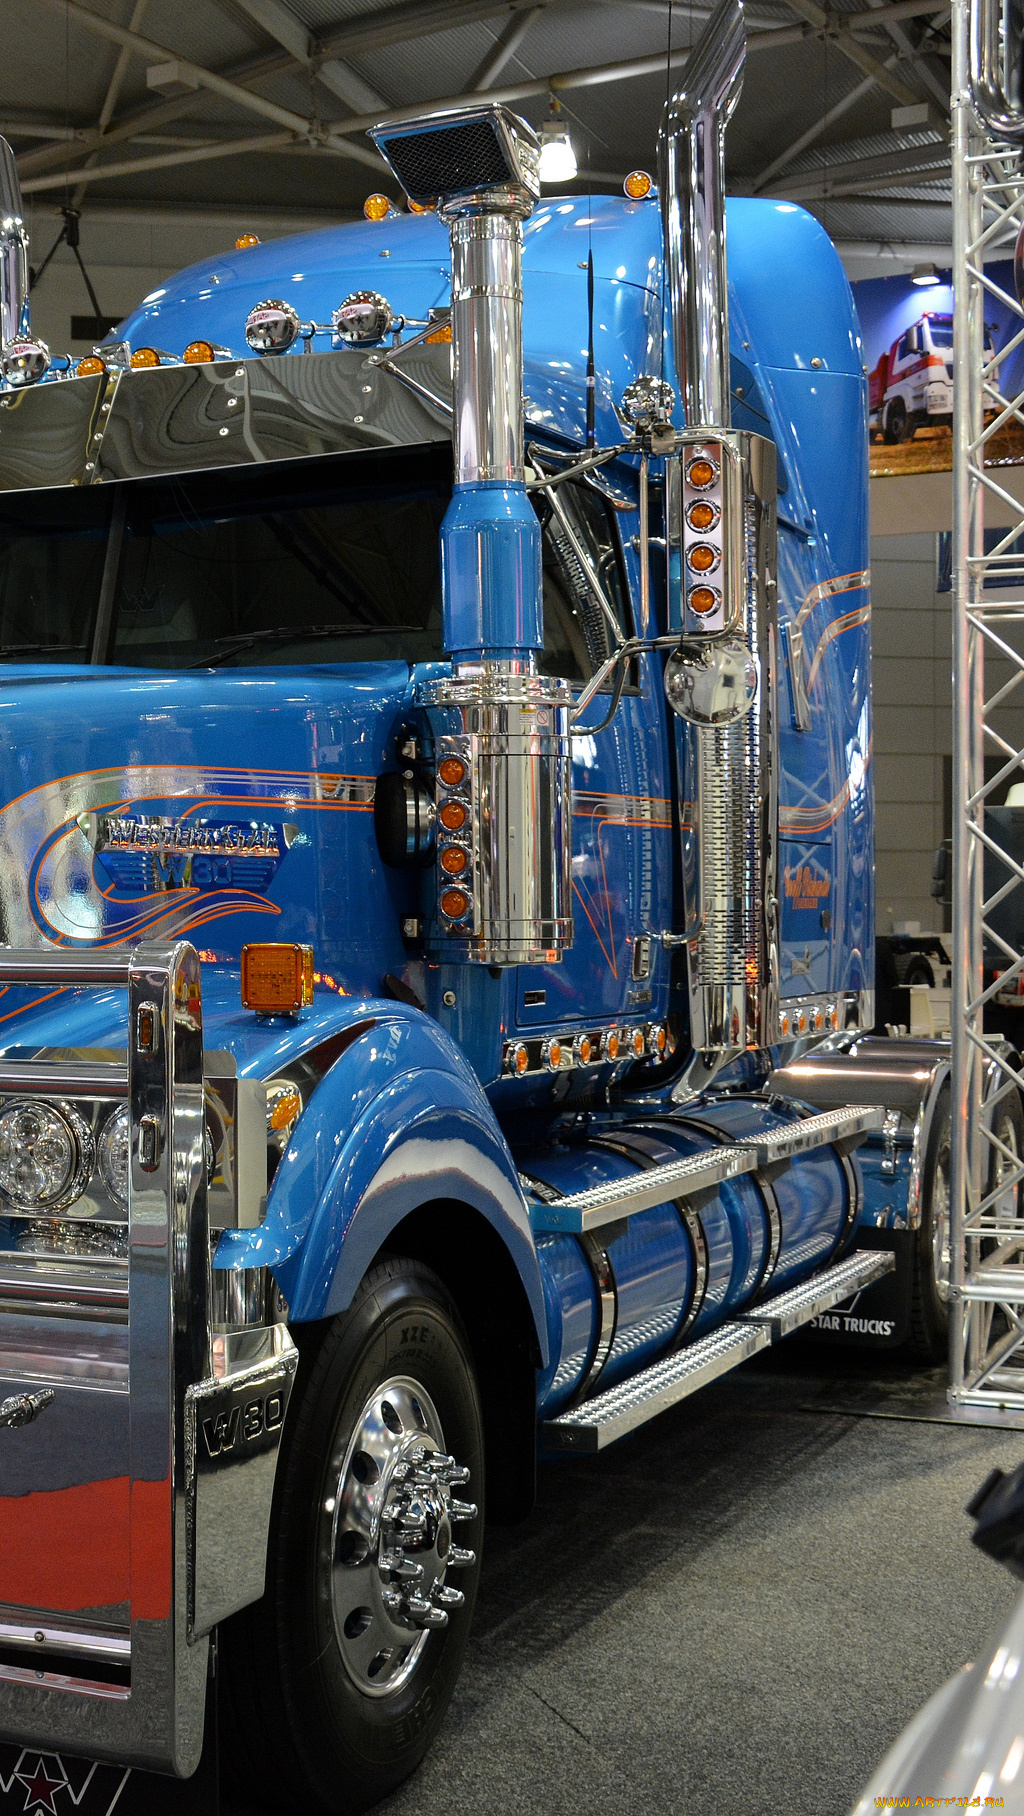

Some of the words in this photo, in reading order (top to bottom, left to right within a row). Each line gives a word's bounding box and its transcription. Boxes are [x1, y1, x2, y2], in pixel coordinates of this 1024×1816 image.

[107, 819, 219, 850] WESTERN
[226, 825, 279, 855] STAR
[843, 1317, 893, 1336] TRUCKS
